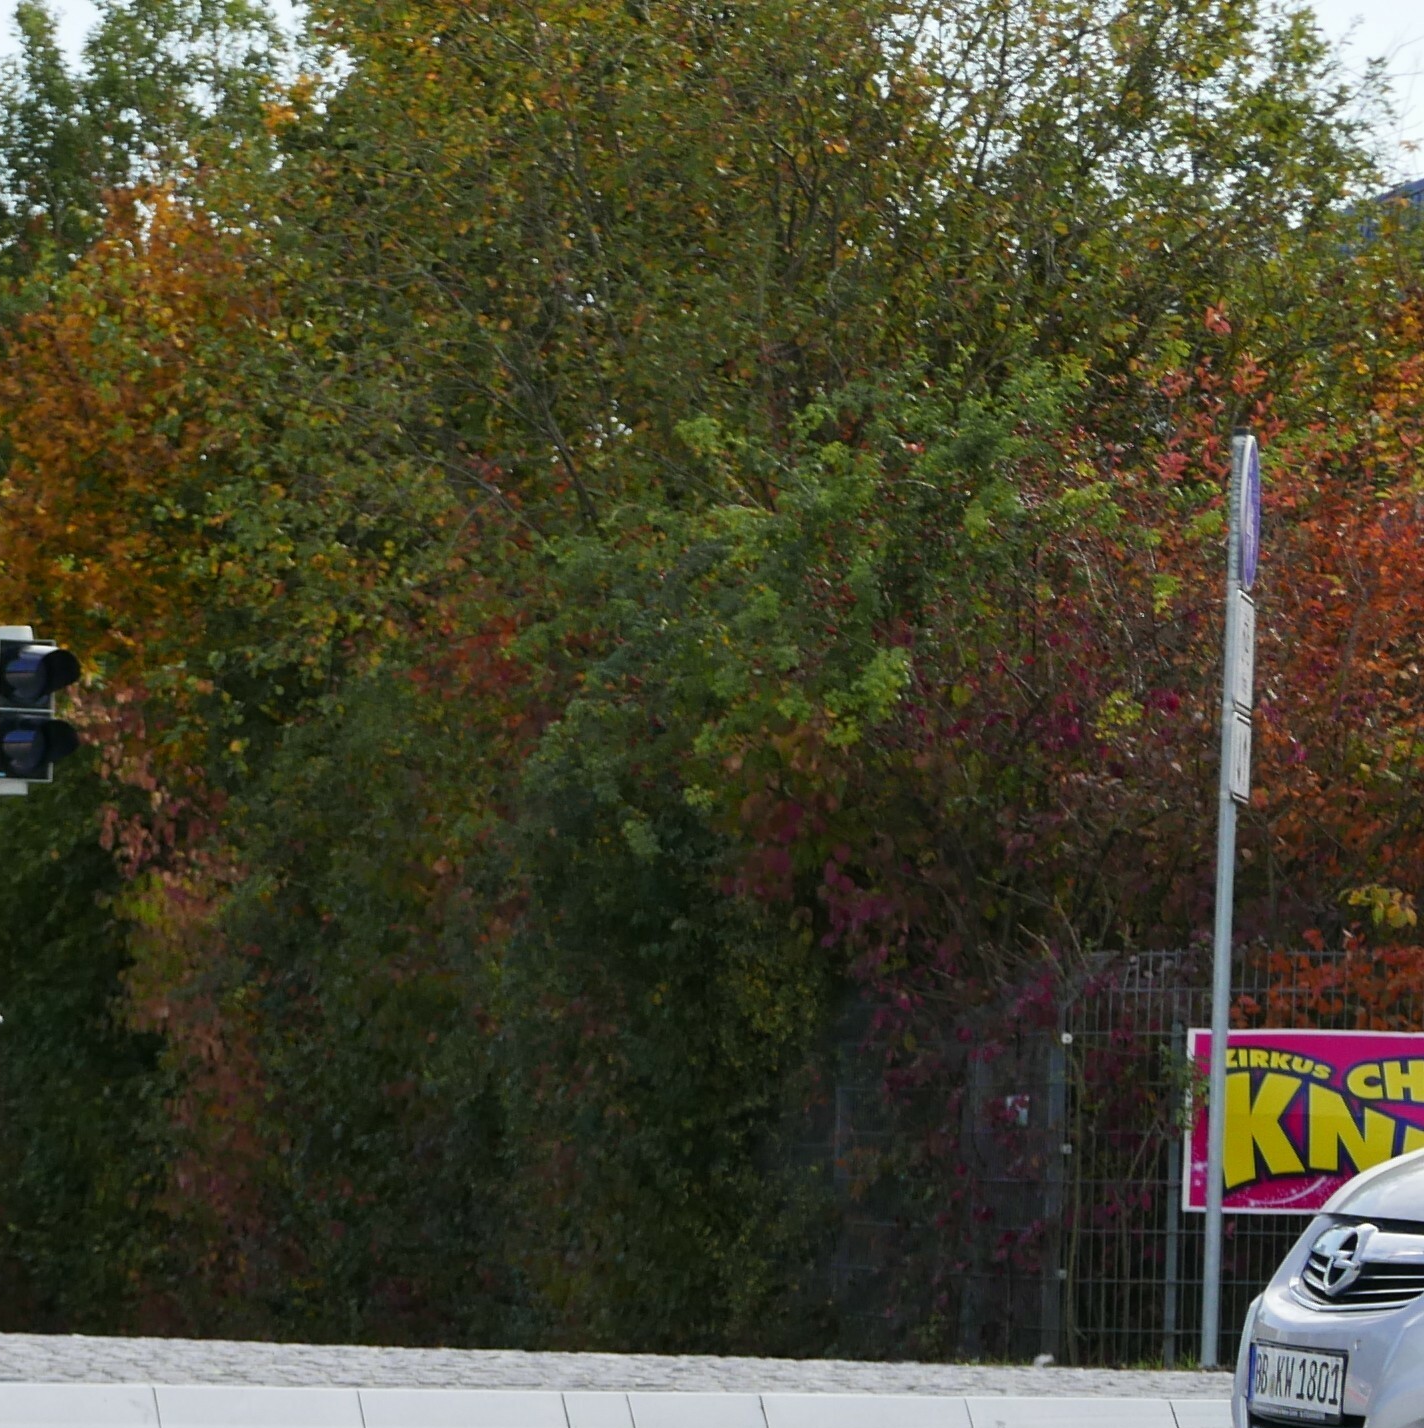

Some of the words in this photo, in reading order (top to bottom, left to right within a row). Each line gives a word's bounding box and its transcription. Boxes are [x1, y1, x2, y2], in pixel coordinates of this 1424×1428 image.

[1226, 1048, 1332, 1080] ZIRKUS
[1222, 1072, 1424, 1190] KN
[1296, 1358, 1340, 1406] 1801
